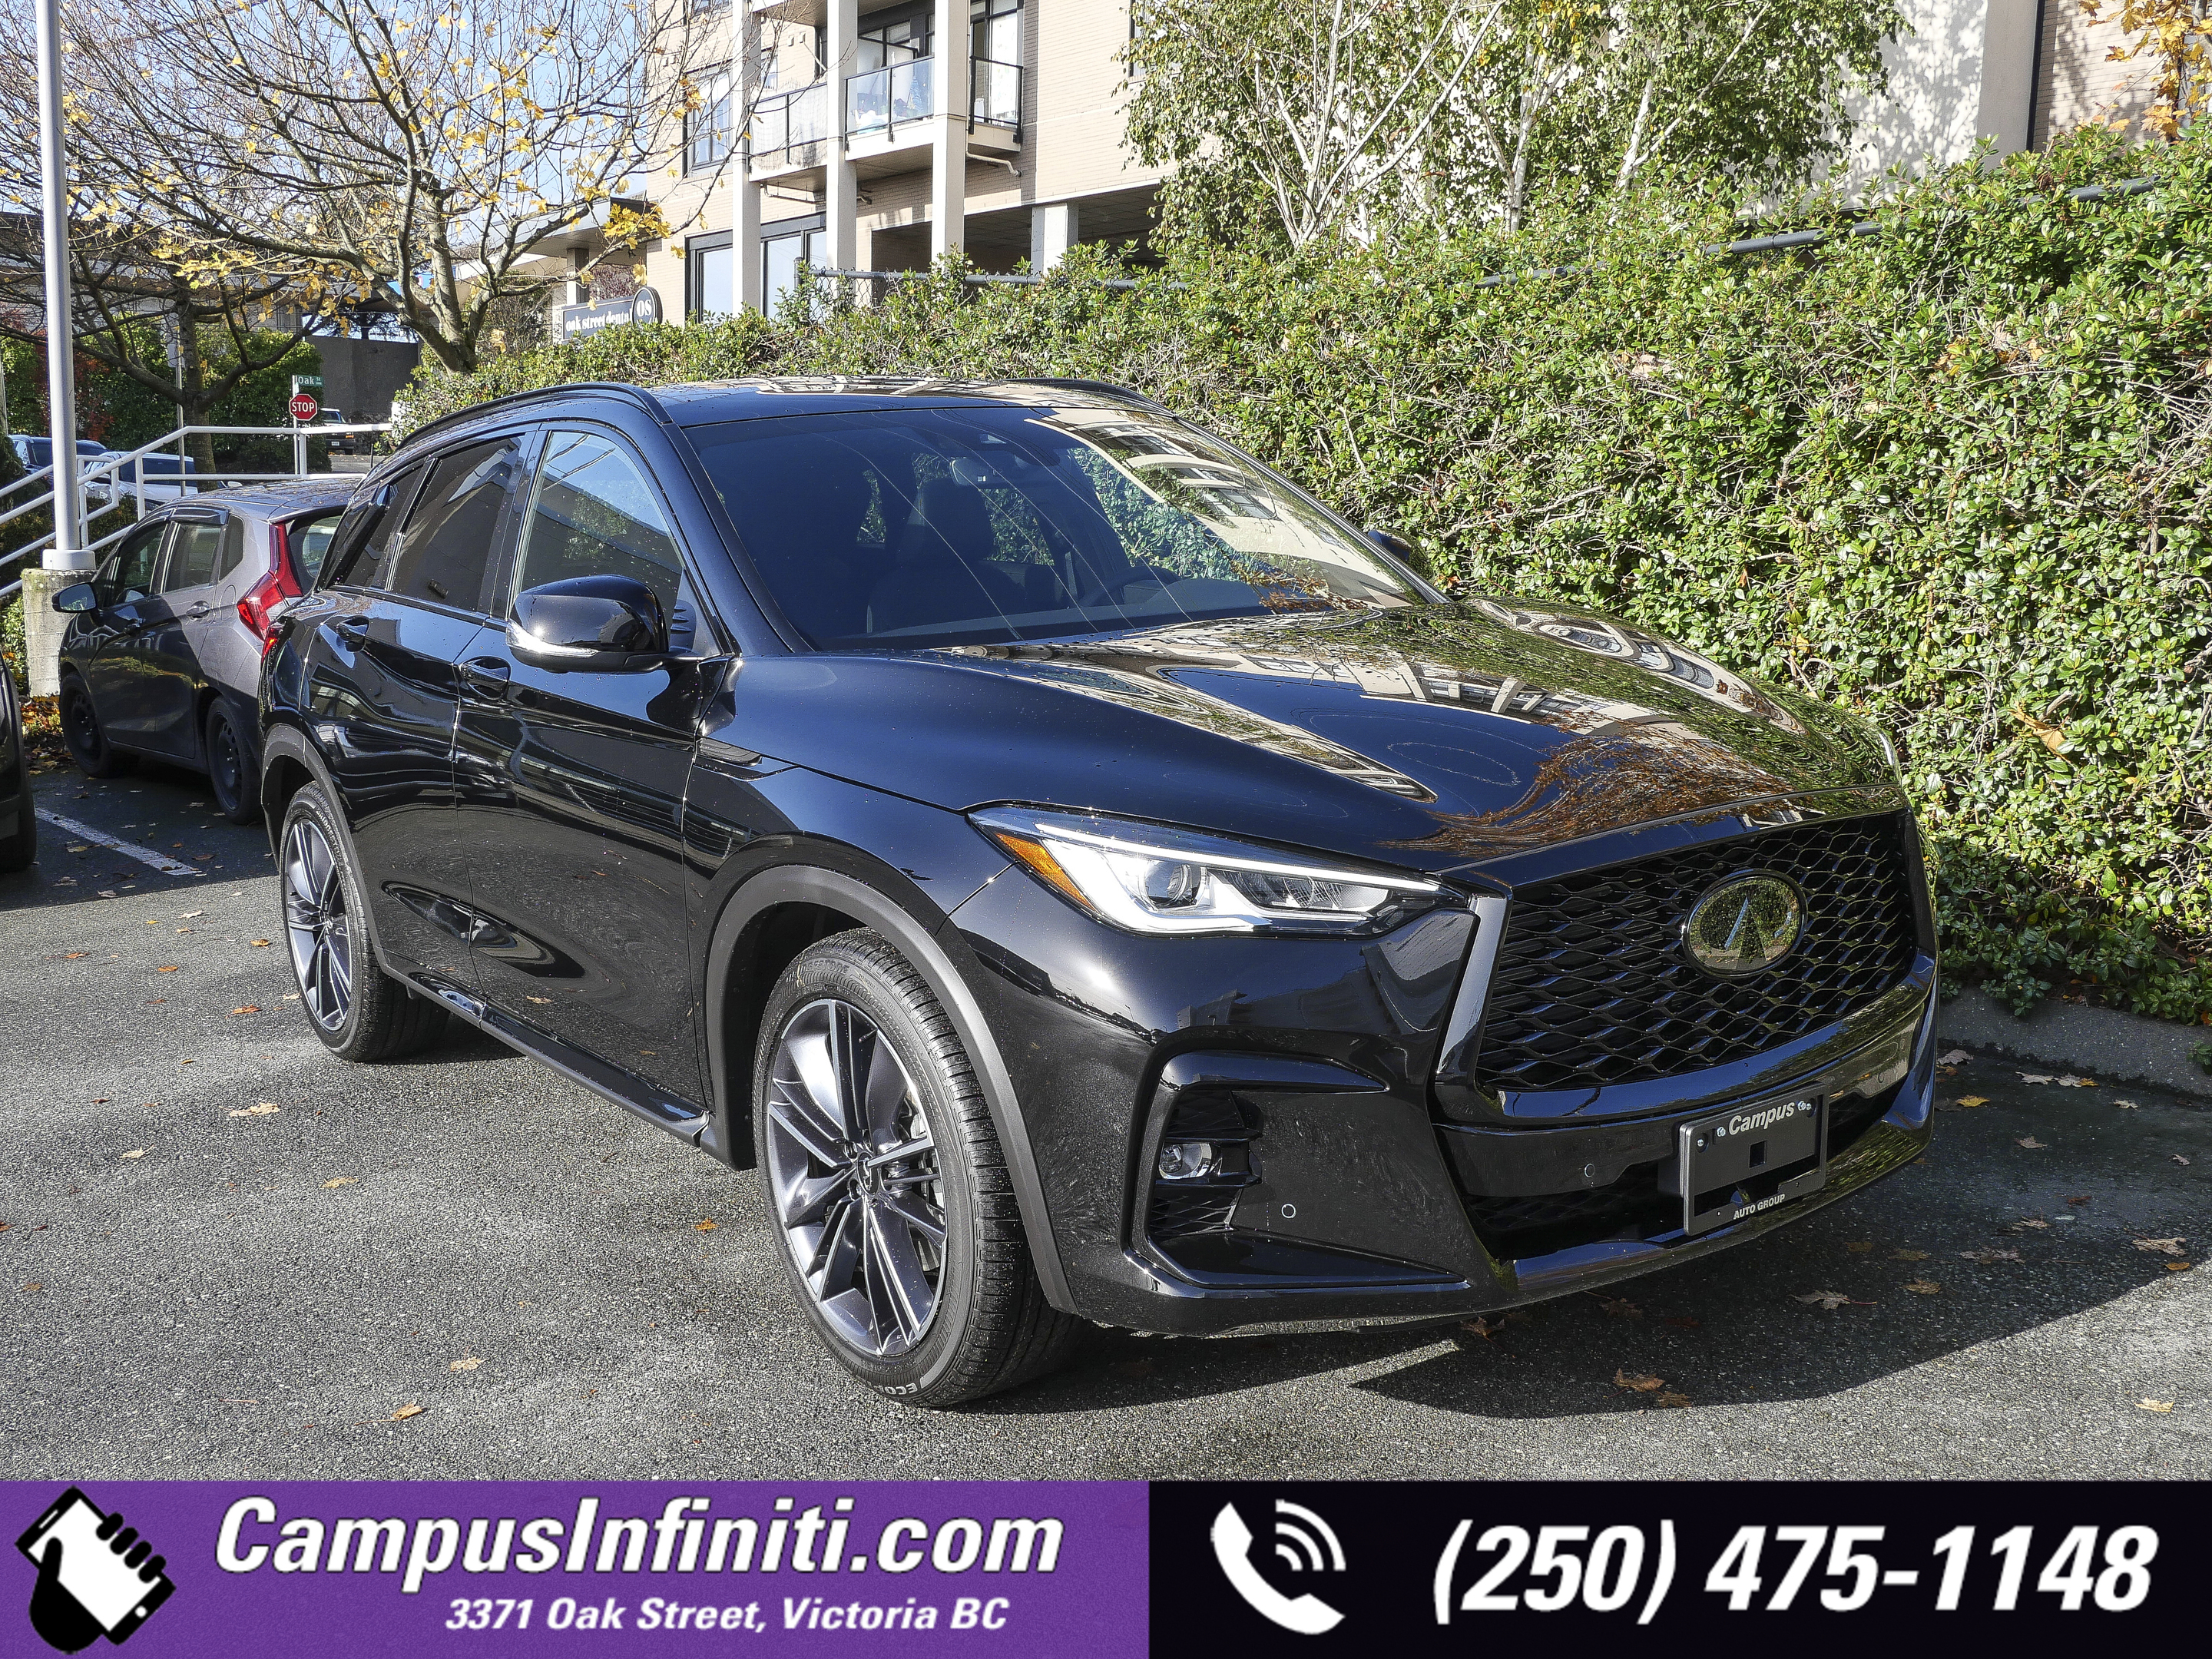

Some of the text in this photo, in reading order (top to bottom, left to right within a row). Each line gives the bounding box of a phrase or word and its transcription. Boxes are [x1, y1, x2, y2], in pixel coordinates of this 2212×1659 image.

[636, 300, 652, 317] OS
[566, 315, 581, 332] oak
[582, 310, 606, 329] street
[298, 376, 314, 385] Oak
[292, 402, 315, 412] STOP
[1728, 1101, 1795, 1135] Campus
[1733, 1194, 1786, 1220] AUTO GROUP
